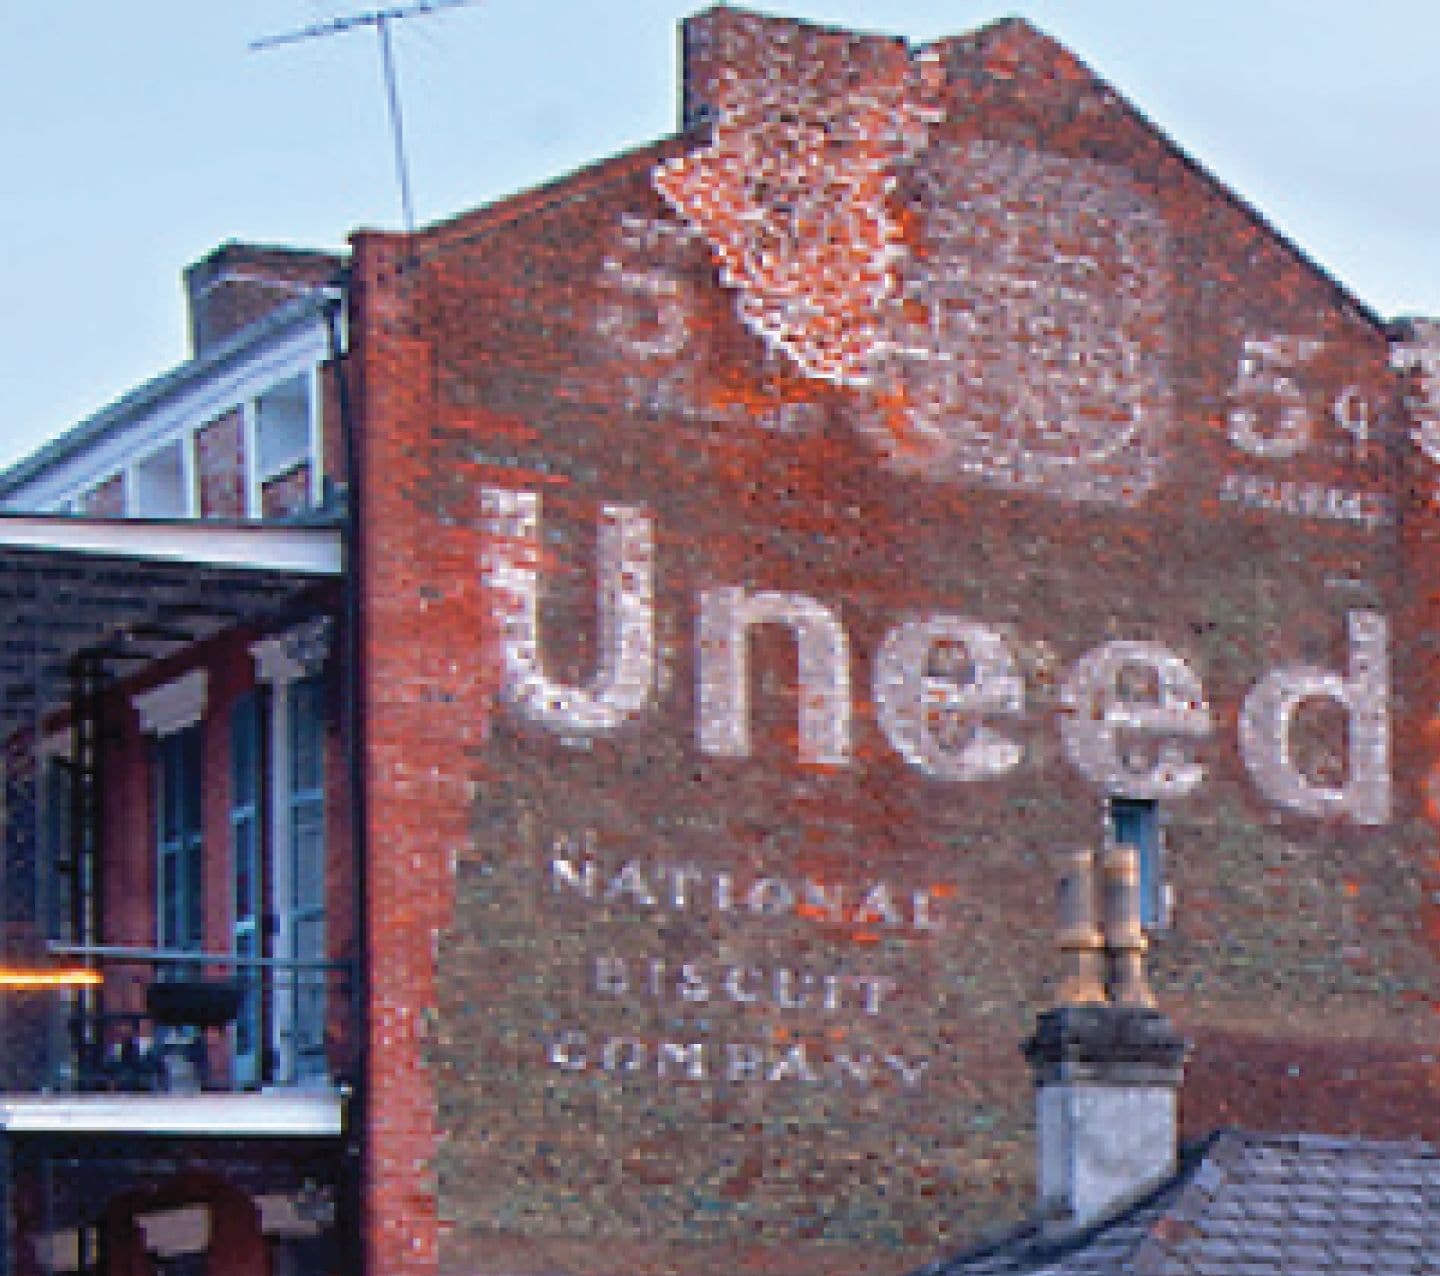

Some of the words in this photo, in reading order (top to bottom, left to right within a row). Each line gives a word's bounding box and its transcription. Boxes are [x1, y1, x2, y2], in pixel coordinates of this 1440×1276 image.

[548, 850, 947, 932] NATIONAL
[594, 955, 898, 1016] BISCUIT
[546, 1030, 930, 1086] COMPANY
